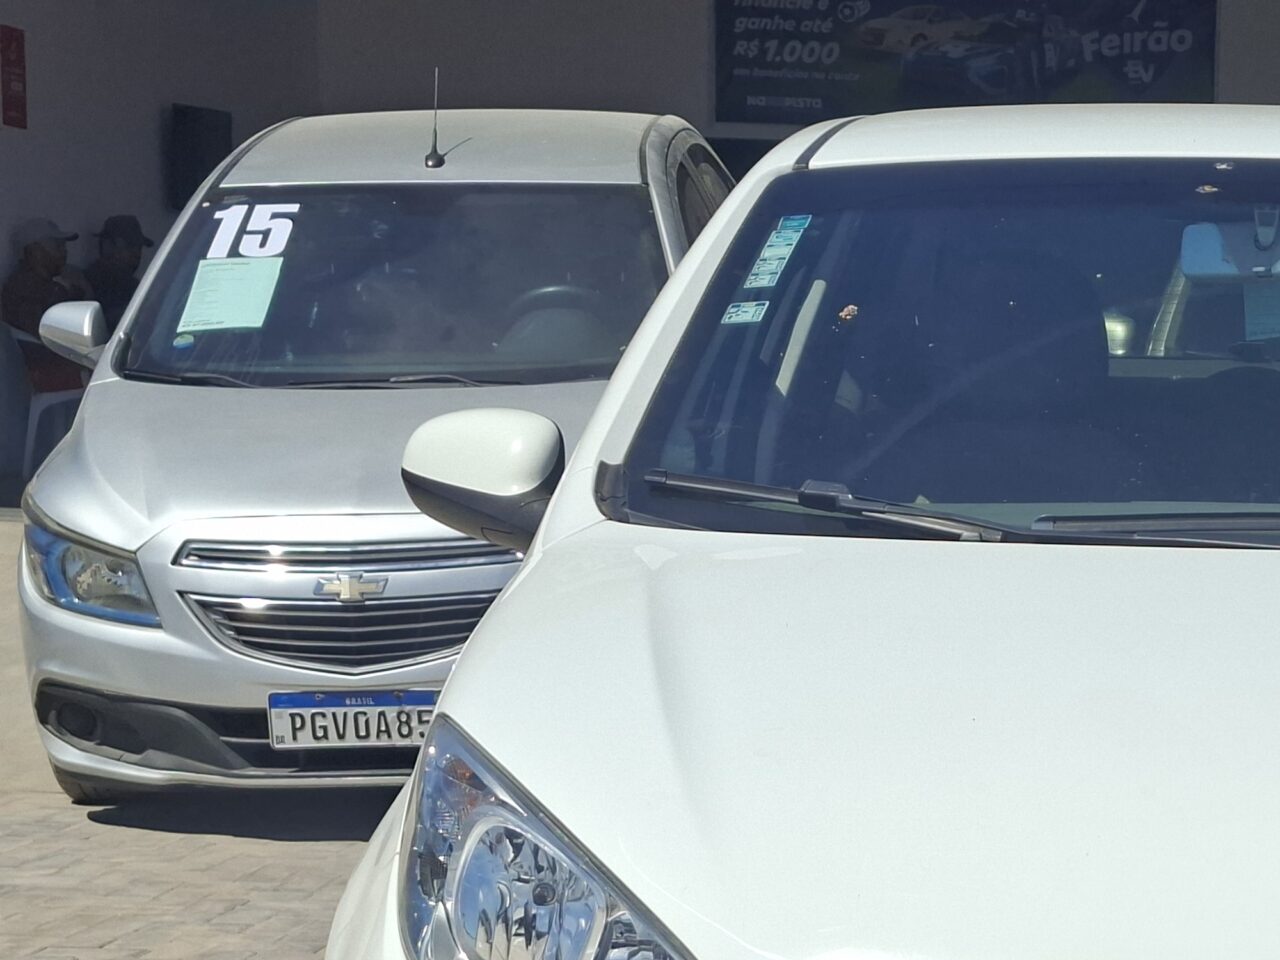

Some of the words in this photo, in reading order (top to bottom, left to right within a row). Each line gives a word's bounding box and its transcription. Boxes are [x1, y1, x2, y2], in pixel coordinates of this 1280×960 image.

[733, 15, 797, 33] ganhe
[799, 17, 834, 33] até
[733, 38, 760, 58] R$
[763, 39, 840, 64] 1.000
[1081, 20, 1193, 62] Feirão
[206, 203, 301, 258] 15
[345, 696, 375, 705] BRASIL
